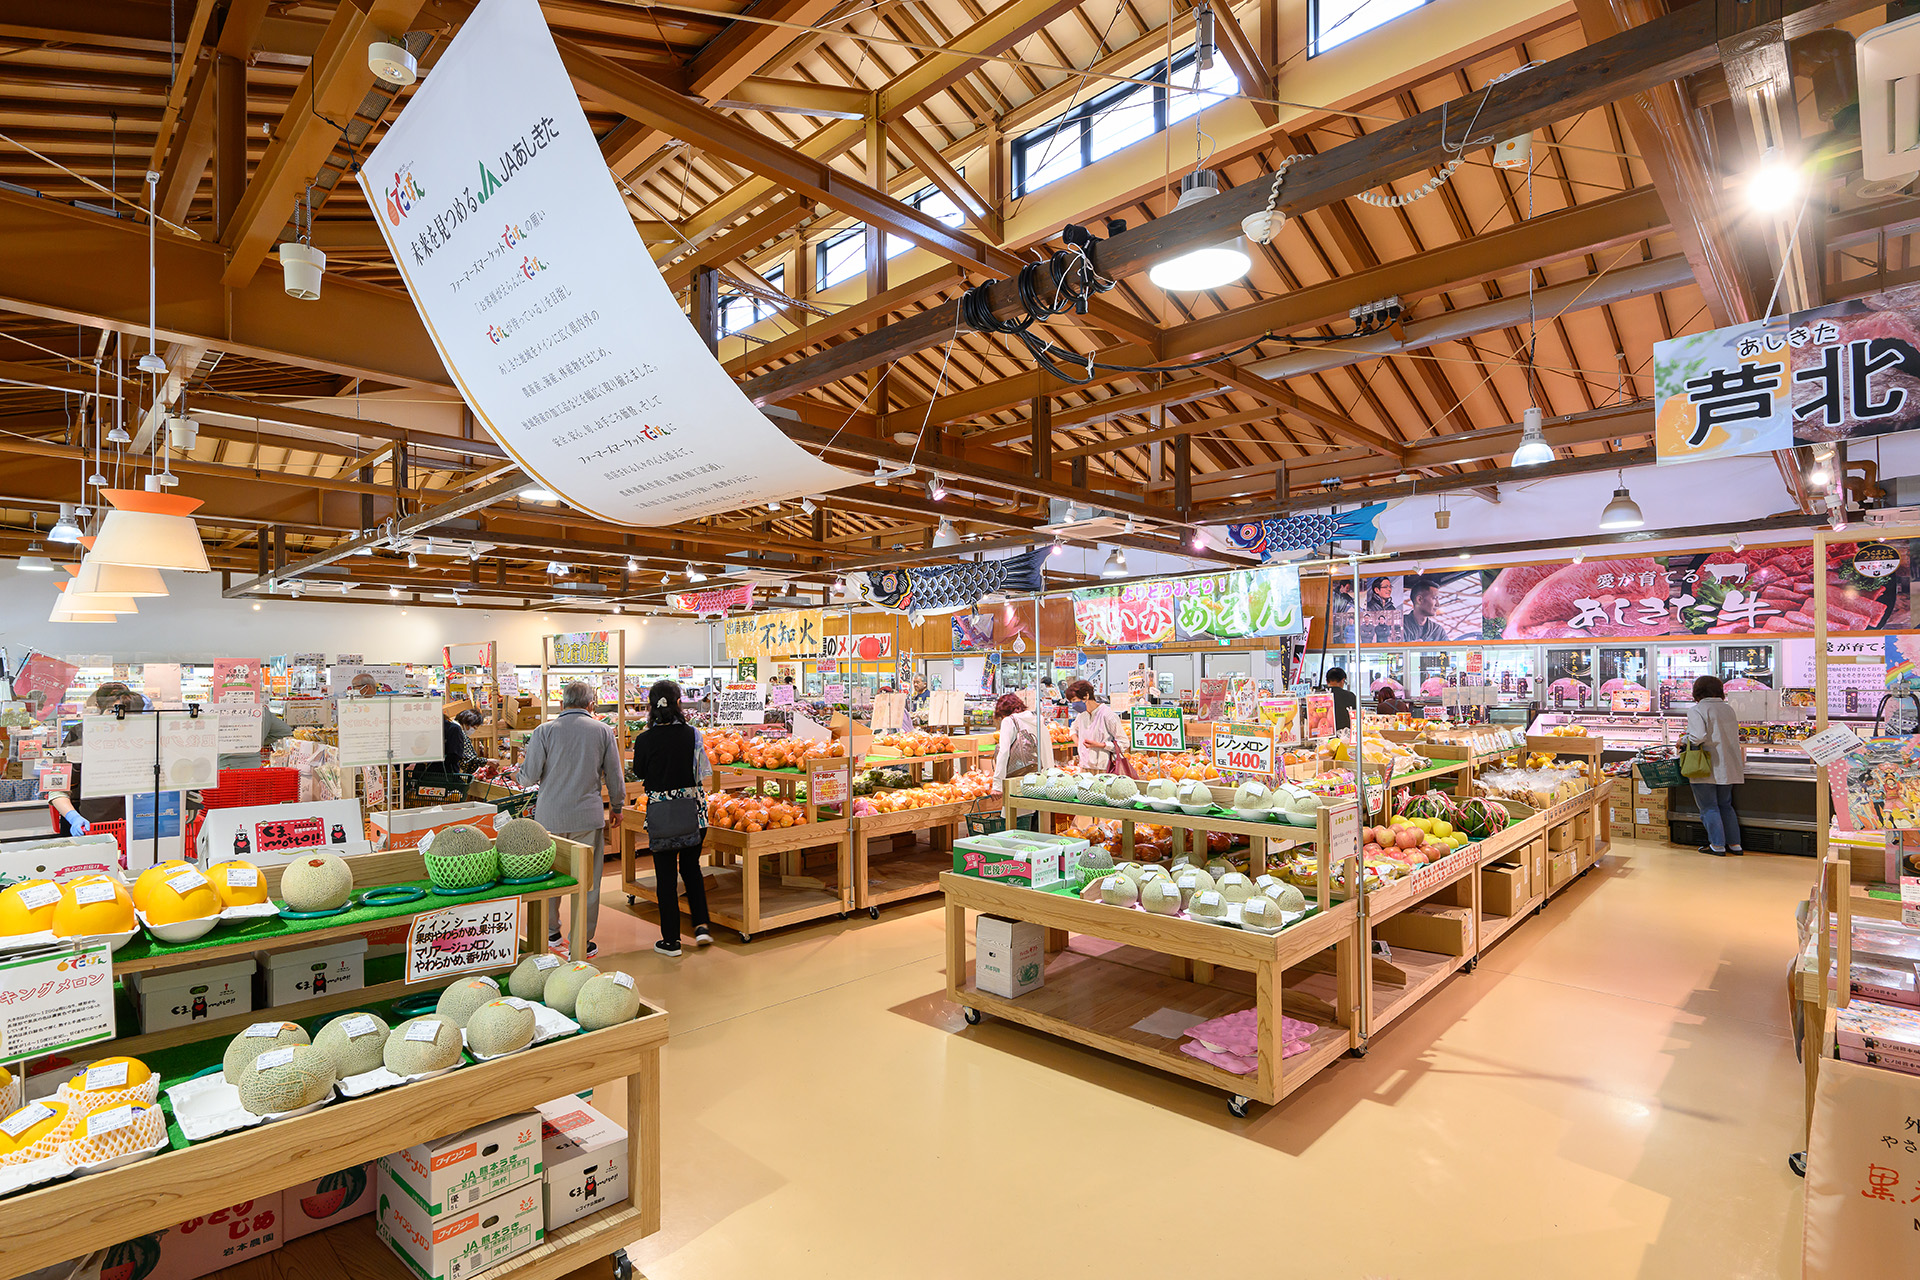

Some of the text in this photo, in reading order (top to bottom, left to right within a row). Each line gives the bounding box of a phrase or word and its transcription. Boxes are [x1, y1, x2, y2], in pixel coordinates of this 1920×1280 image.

[410, 187, 478, 267] 未来を見つめる
[1739, 323, 1839, 358] あしきた
[1685, 341, 1906, 447] 芦北
[1596, 568, 1700, 589] 愛が育てる
[1177, 589, 1298, 637] めろん
[1567, 591, 1782, 629] あしきた牛
[759, 618, 818, 650] 不知火
[1135, 721, 1179, 731] アンデスメロン
[1144, 732, 1173, 747] 1200
[1216, 738, 1269, 752] レノンメロン
[1227, 751, 1260, 769] 1400
[983, 863, 1026, 876] 肥後グリーン
[415, 922, 513, 945] 果肉やわらかめ、果汁多い
[417, 911, 514, 933] クインシーメロン
[414, 948, 512, 973] やわらかめ、香りがいい
[415, 940, 495, 960] マリアージュメロン
[0, 973, 105, 1005] キングメロン
[436, 1149, 472, 1168] クインシー
[461, 1154, 518, 1183] JA 熊本うき
[393, 1209, 430, 1252] クインシーメロン
[437, 1220, 474, 1240] クインシー
[463, 1221, 520, 1254] JA 熊本うき
[222, 1233, 275, 1257] 岩本農園
